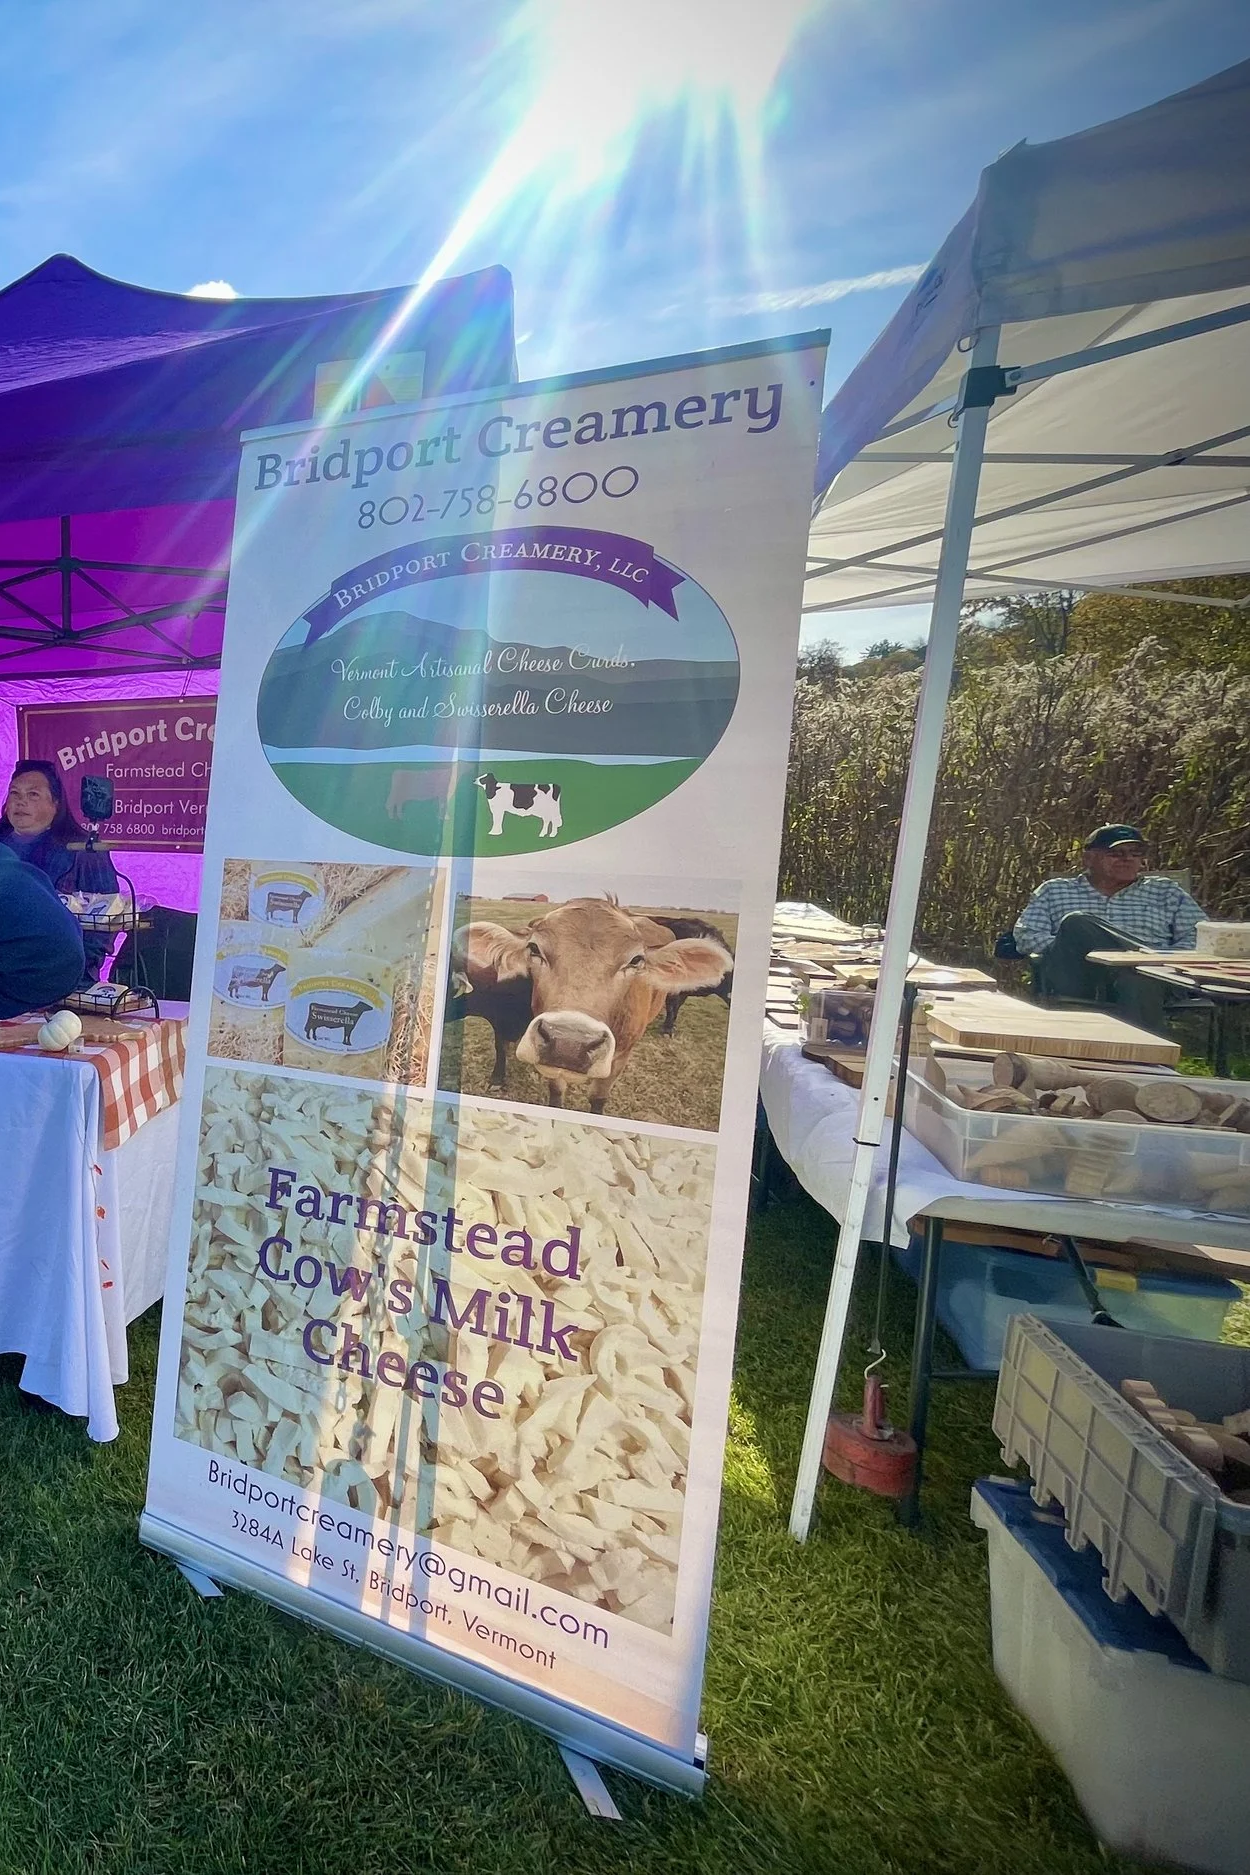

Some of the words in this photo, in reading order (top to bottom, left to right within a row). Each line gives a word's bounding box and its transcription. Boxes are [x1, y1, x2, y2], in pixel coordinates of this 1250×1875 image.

[254, 424, 461, 491] Bridport
[478, 380, 783, 458] Creamery
[358, 465, 639, 530] 802-758-6800
[333, 550, 451, 610] BRIDPORT
[460, 541, 601, 573] CREAMERY,
[609, 557, 650, 584] LLC
[330, 656, 399, 682] Vermont
[401, 650, 493, 678] Artisanal
[497, 646, 564, 674] Cheese
[343, 695, 395, 728] Colby
[398, 696, 430, 719] and
[432, 689, 540, 719] Swisserella
[544, 687, 614, 715] Cheese
[56, 718, 168, 771] Bridport
[106, 762, 185, 778] Farmstead
[103, 823, 123, 834] 758
[126, 823, 155, 835] 6800
[114, 798, 175, 818] Bridport
[265, 1166, 582, 1281] Farmstead
[259, 1235, 413, 1315] Cow's
[430, 1277, 579, 1362] Milk
[302, 1318, 505, 1420] Cheese
[207, 1459, 611, 1650] Bridportcreamery@gmail.com
[232, 1509, 284, 1551] 3284A
[291, 1537, 334, 1571] Lake
[462, 1609, 557, 1670] Vermont
